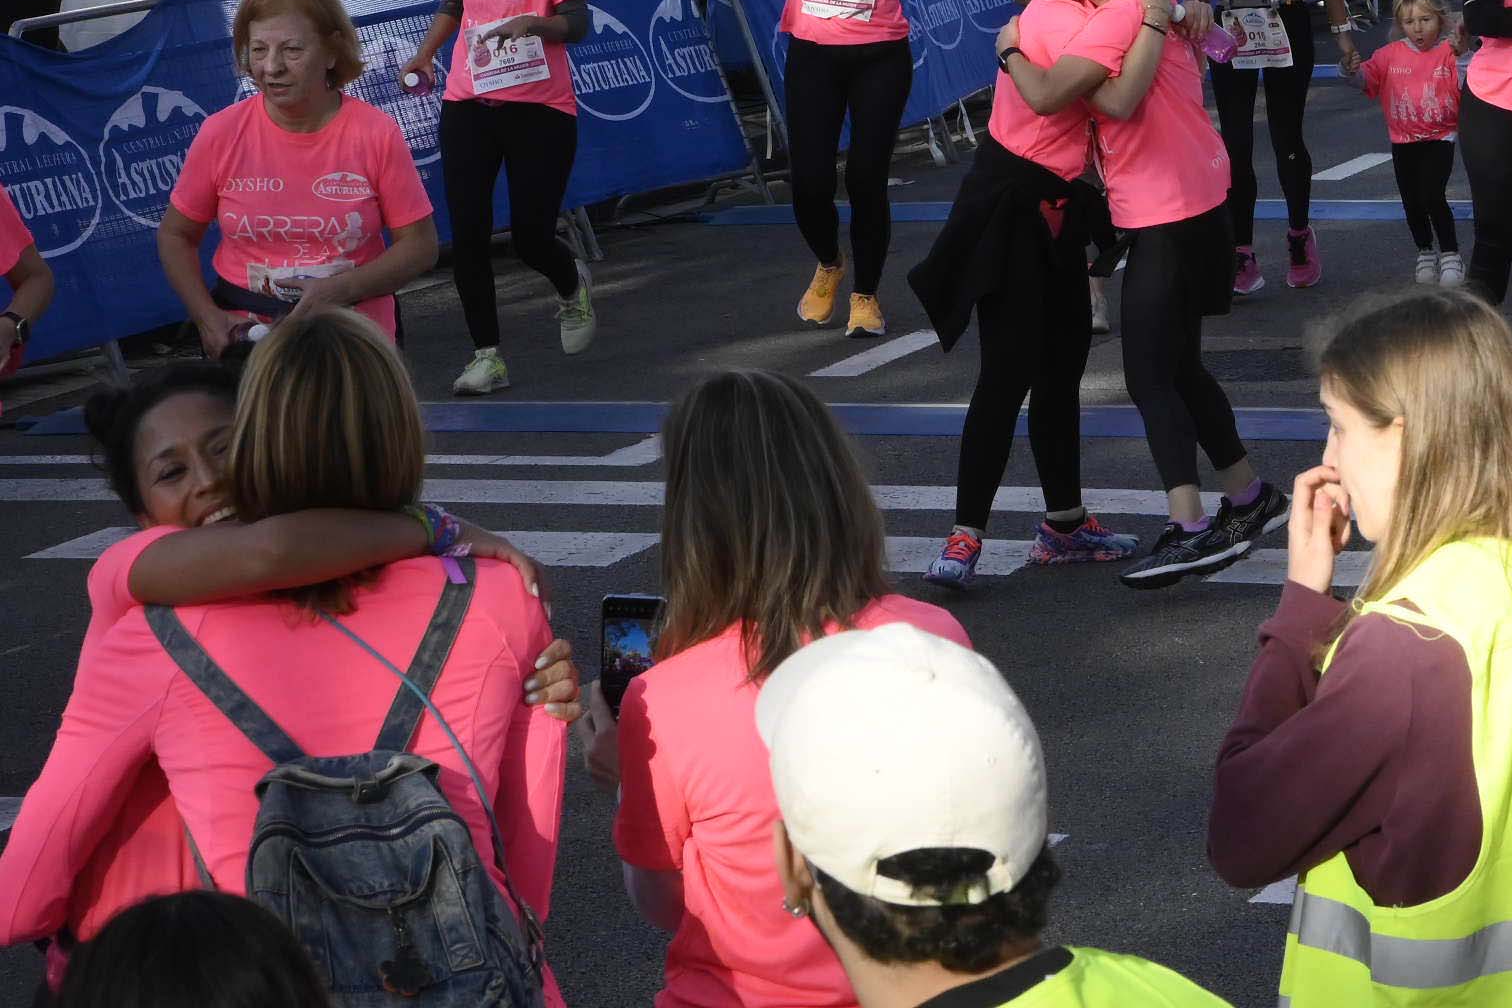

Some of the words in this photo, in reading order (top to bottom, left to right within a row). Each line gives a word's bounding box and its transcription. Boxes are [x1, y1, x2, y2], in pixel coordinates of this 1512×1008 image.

[566, 55, 650, 94] ASTURIANA
[317, 183, 371, 195] ASTURIANA
[223, 212, 342, 242] CARRERA
[292, 243, 311, 258] DE
